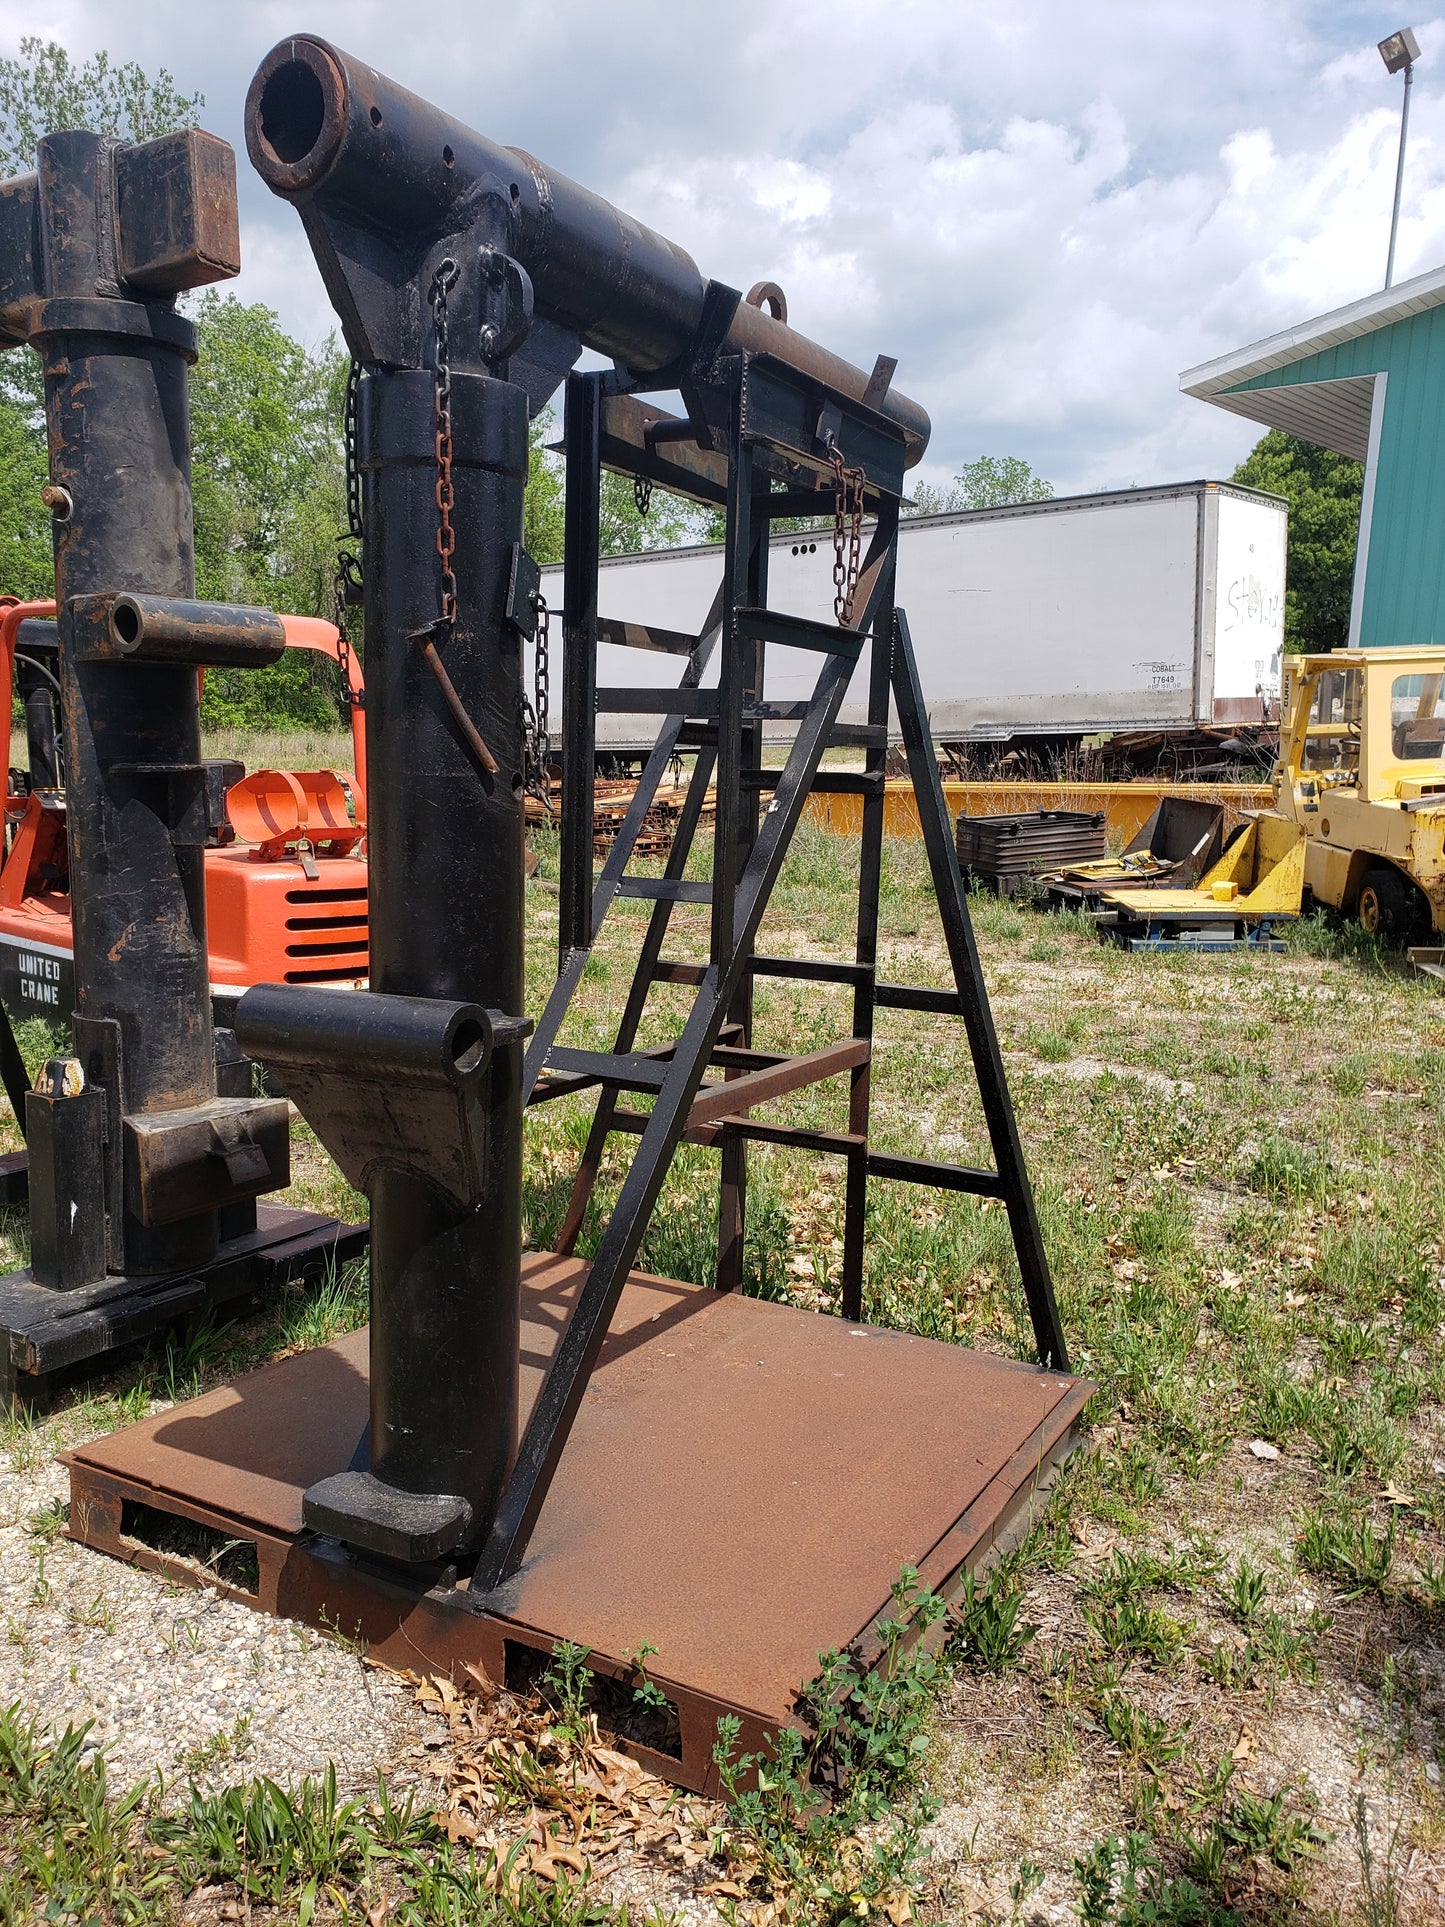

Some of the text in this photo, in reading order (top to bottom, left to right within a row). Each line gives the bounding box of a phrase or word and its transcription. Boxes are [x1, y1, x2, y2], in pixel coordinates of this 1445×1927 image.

[1151, 665, 1176, 673] COBALT
[1152, 676, 1175, 684] T7649
[18, 953, 60, 981] UNITED
[21, 978, 59, 1006] CRANE
